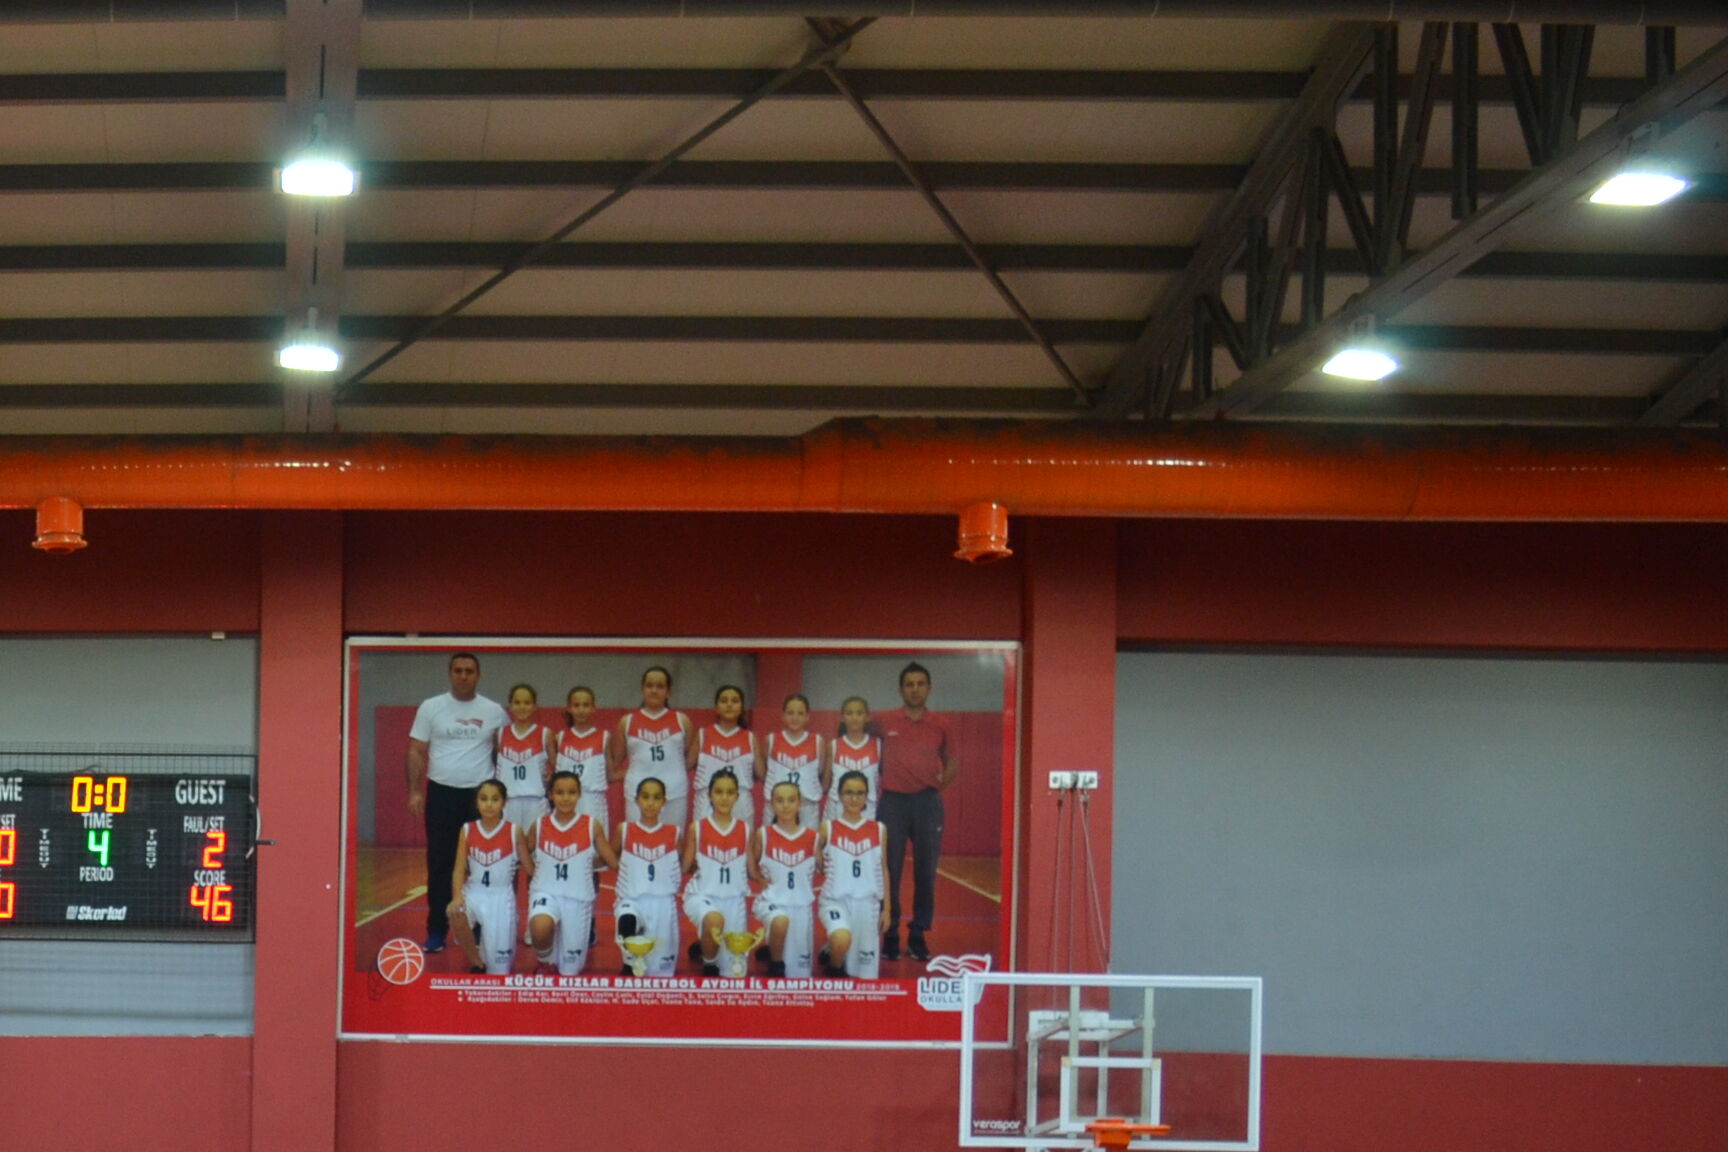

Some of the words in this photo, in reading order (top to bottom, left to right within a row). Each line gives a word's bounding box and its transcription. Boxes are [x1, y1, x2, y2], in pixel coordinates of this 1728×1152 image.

[650, 745, 665, 761] 15
[512, 765, 527, 781] 10
[71, 775, 127, 813] 0:0
[175, 778, 226, 805] GUEST
[80, 812, 114, 829] TIME
[183, 815, 225, 833] FAUL/SET
[88, 829, 110, 867] 4
[202, 831, 226, 868] 2
[79, 866, 114, 882] PERIOD
[193, 869, 226, 886] SCORE
[554, 863, 569, 881] 14
[647, 866, 655, 882] 9
[852, 860, 861, 878] 6
[480, 870, 490, 887] 4
[787, 872, 795, 889] 8
[190, 884, 232, 922] 46
[430, 978, 471, 986] OKULLAR
[474, 979, 500, 987] ARASI
[504, 974, 554, 988] KÜÇÜK
[559, 976, 609, 988] KIZLAR
[614, 977, 697, 990] BASKETBOL
[701, 979, 745, 990] AYDIN
[749, 976, 764, 991] İL
[768, 977, 855, 992] ŞAMPİYONU
[921, 978, 964, 994] LİDE
[921, 995, 962, 1004] OKULLA
